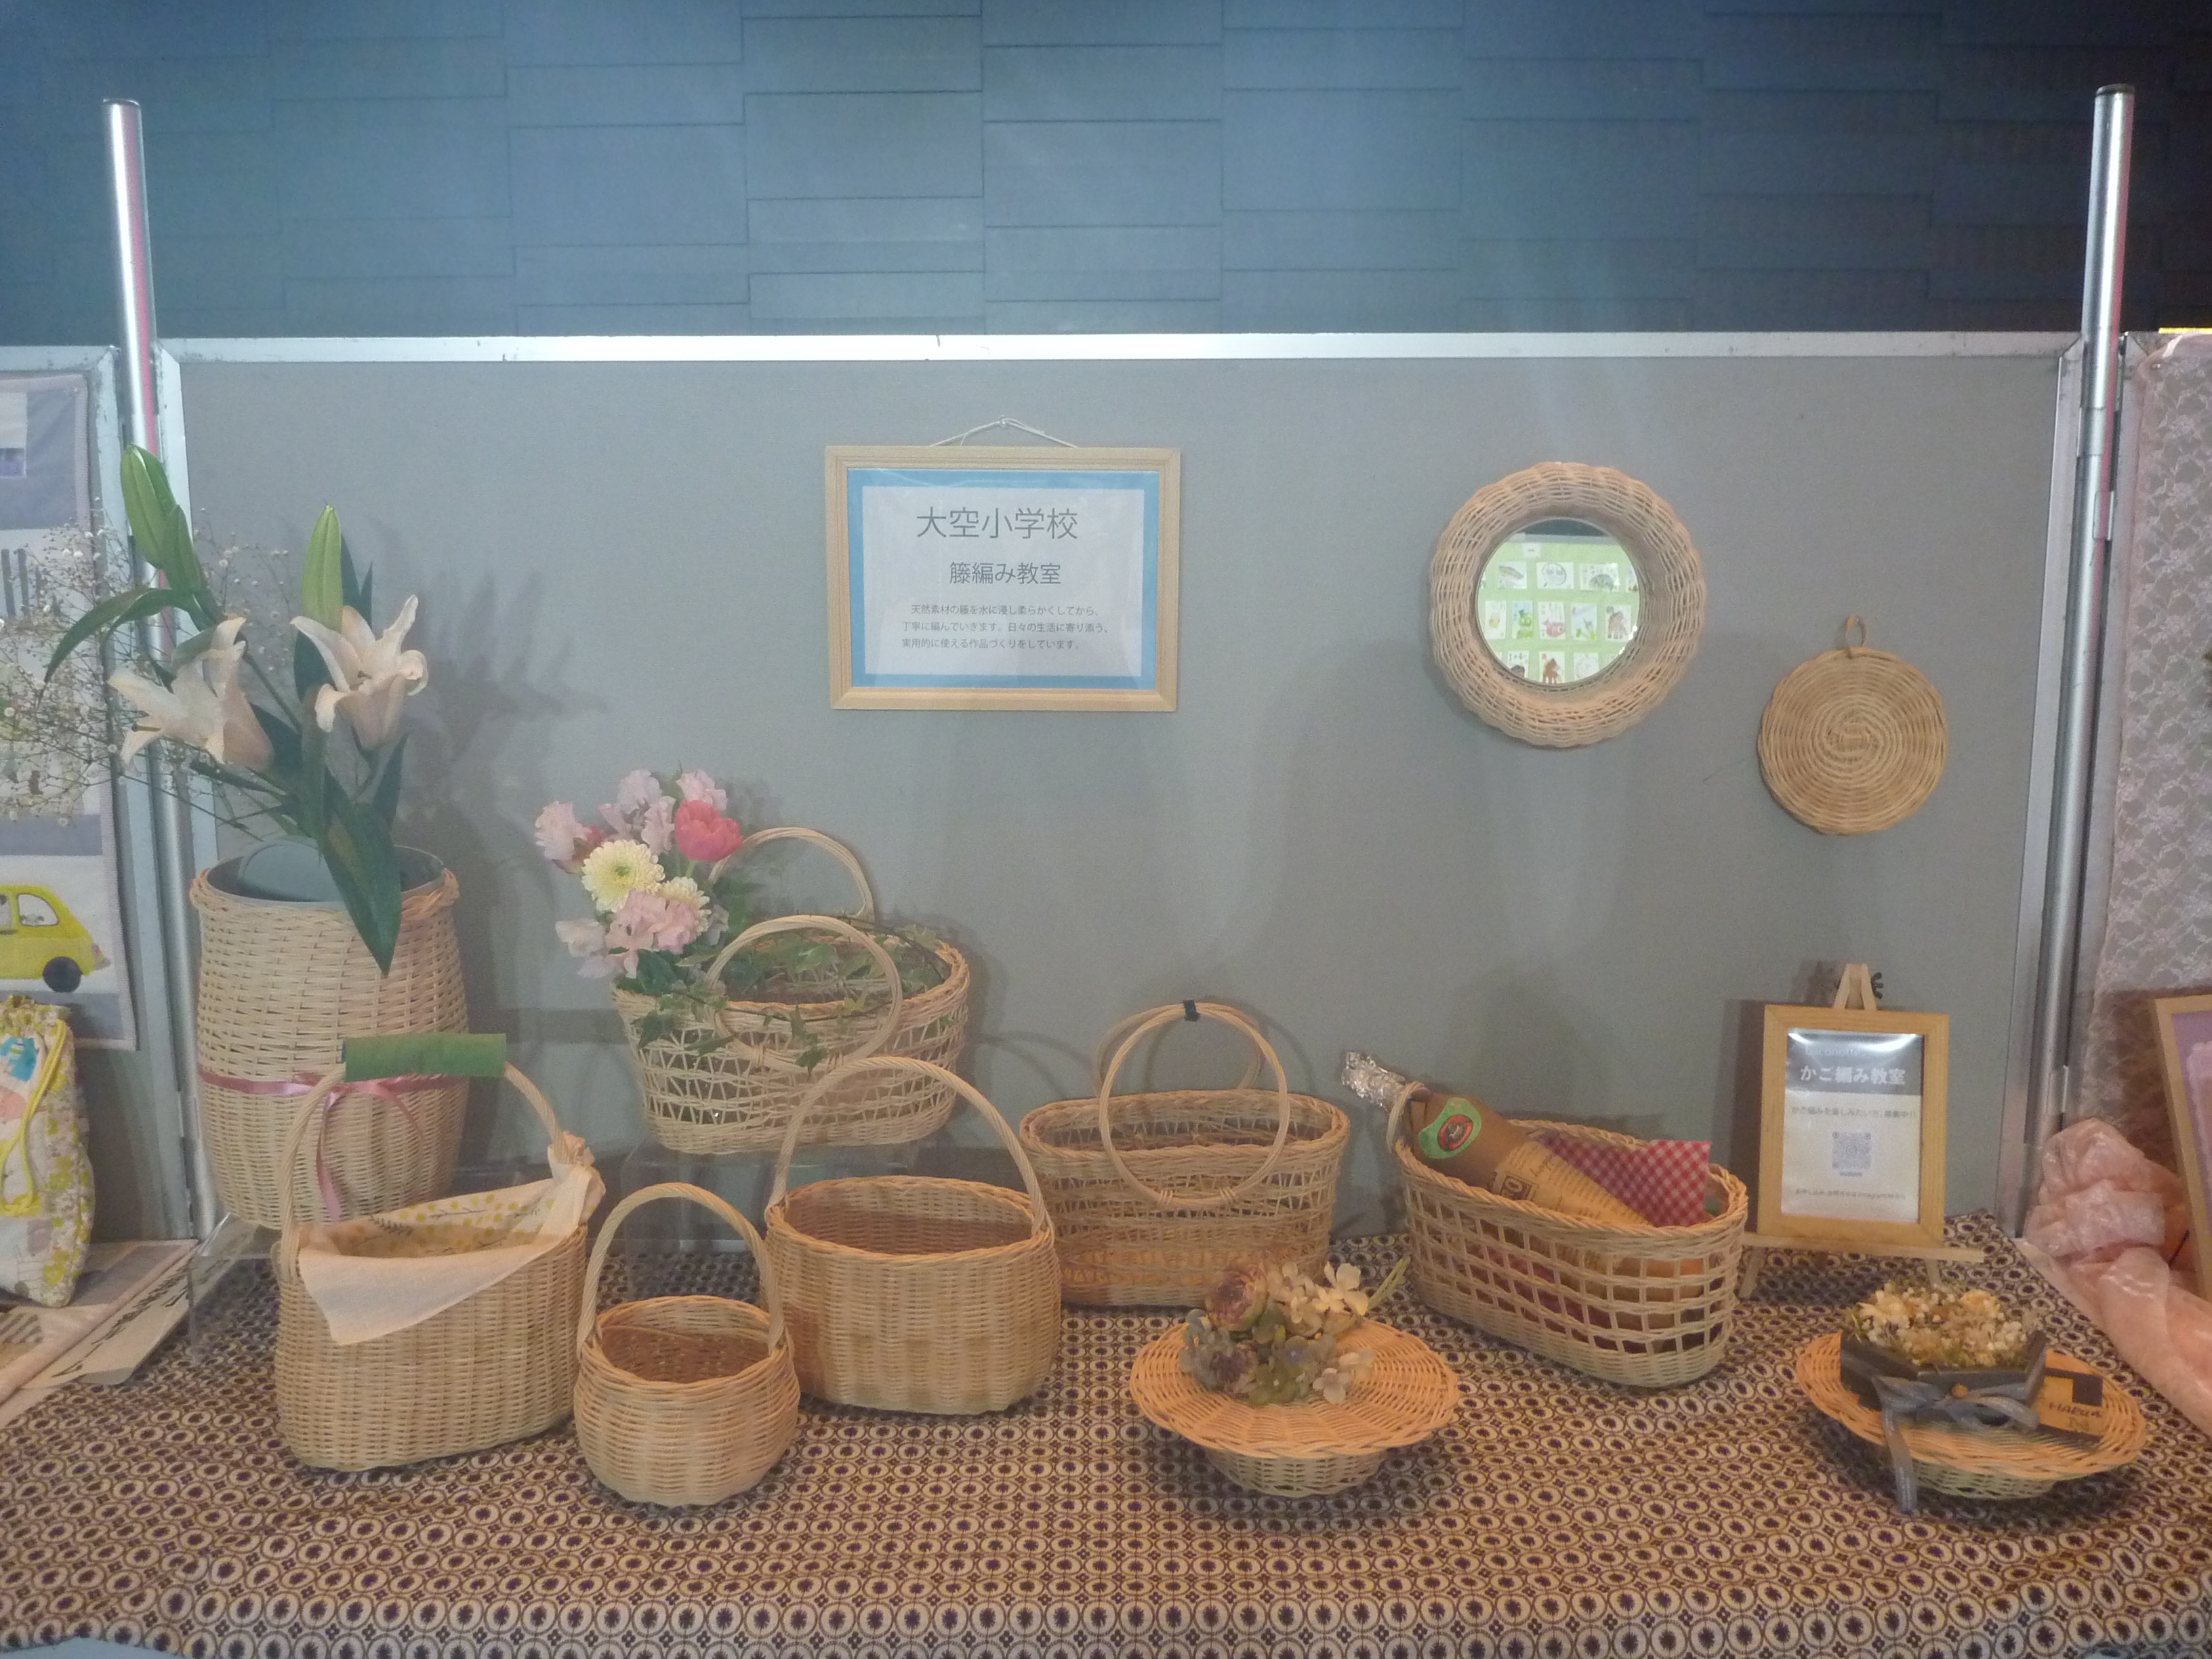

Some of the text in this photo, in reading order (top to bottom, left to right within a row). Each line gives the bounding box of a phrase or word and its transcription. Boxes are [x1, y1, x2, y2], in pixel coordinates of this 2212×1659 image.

[916, 506, 1078, 540] 大空小学校
[1800, 1065, 1906, 1085] かご編み教室
